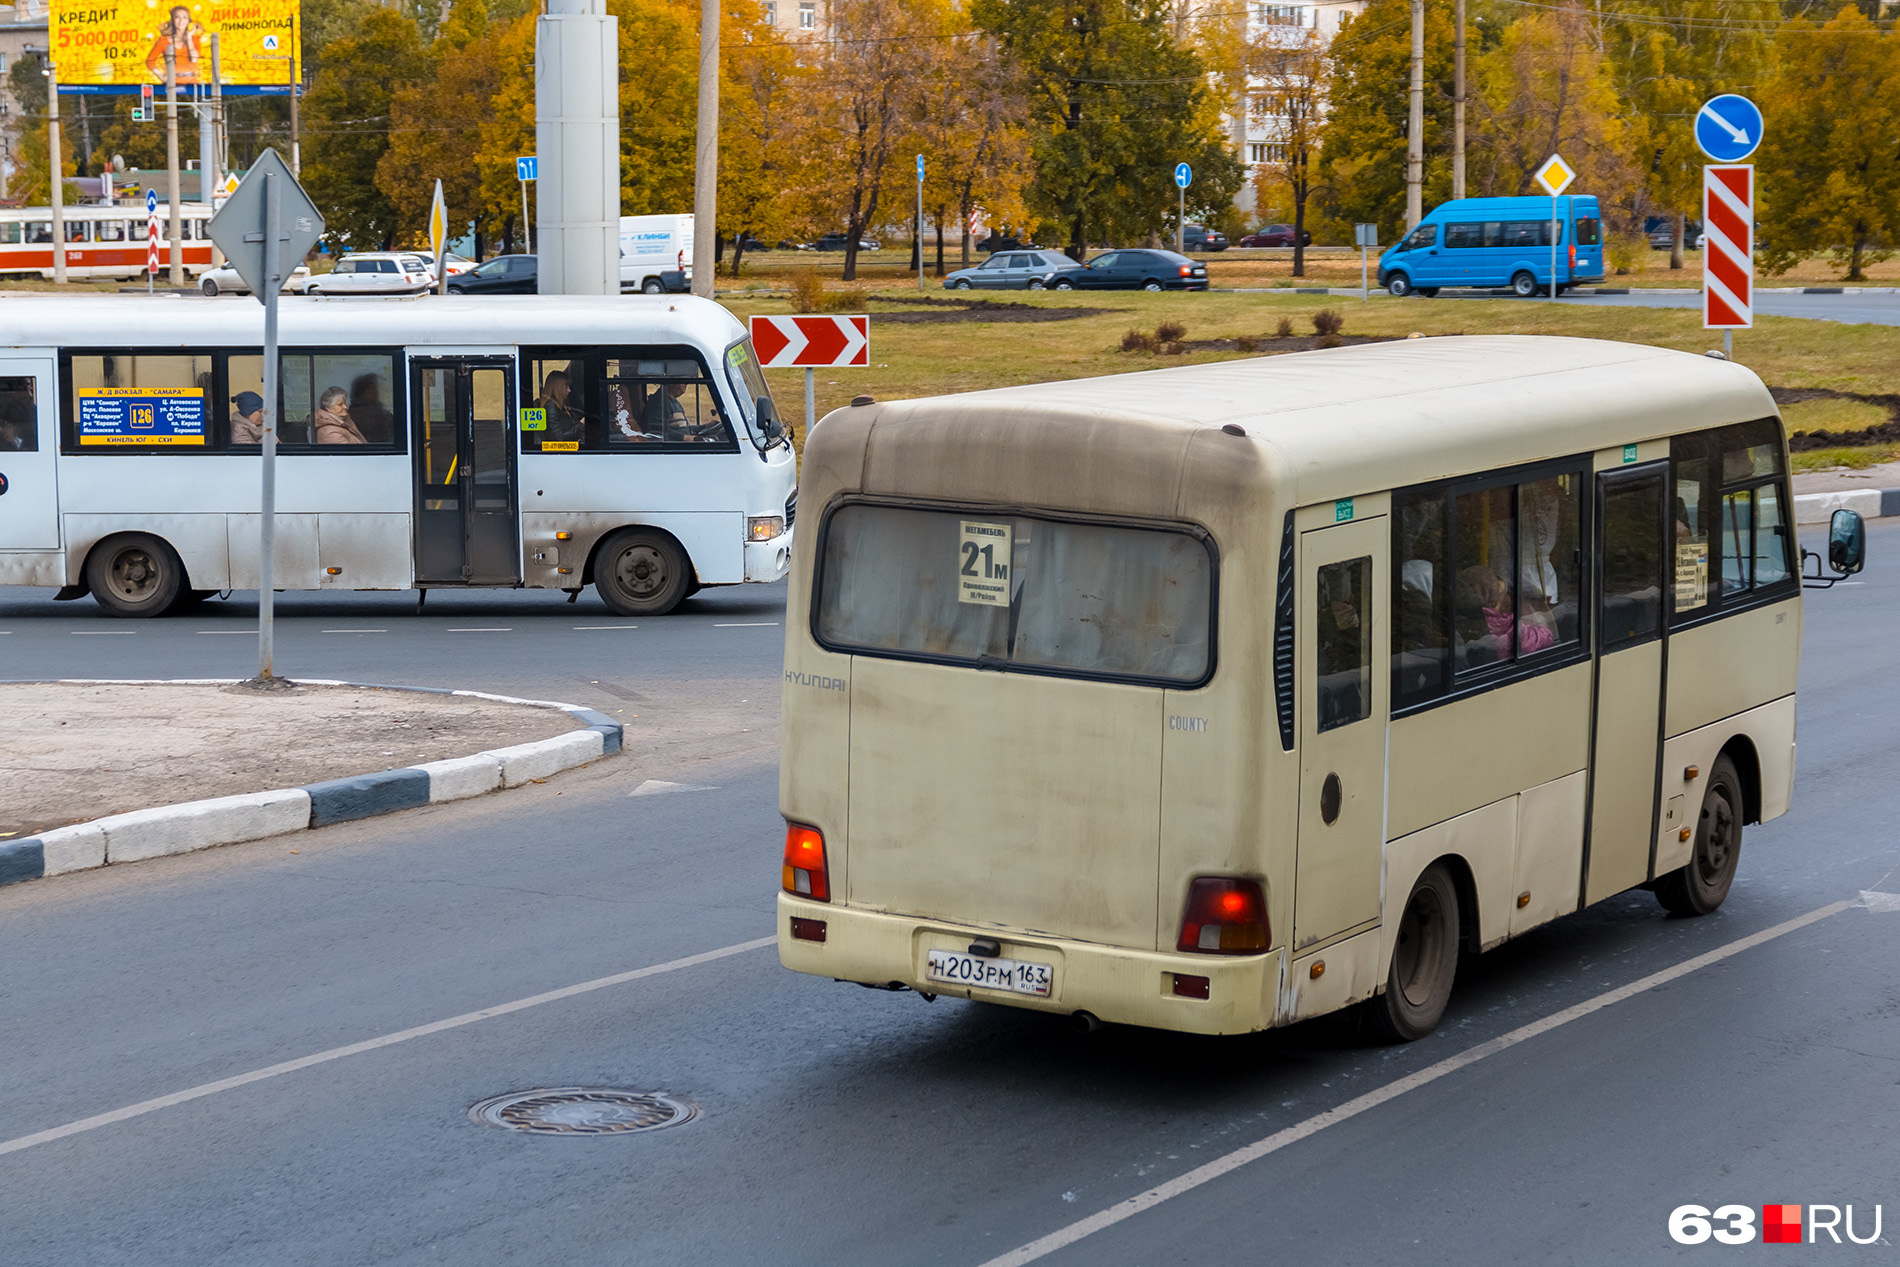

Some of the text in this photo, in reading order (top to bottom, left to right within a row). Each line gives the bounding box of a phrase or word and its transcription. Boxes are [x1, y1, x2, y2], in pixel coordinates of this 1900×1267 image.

[59, 8, 118, 24] КРЕДИТ
[210, 7, 260, 24] ДИКИЙ
[132, 408, 151, 423] 126
[524, 410, 543, 421] 126
[965, 525, 1006, 537] МЕГАМЕБЕЛЬ
[963, 581, 1005, 593] Приволжский
[785, 669, 846, 692] HYUNDAI
[1169, 715, 1208, 732] COUNTY
[1016, 965, 1046, 983] 163
[1020, 983, 1036, 991] RUS
